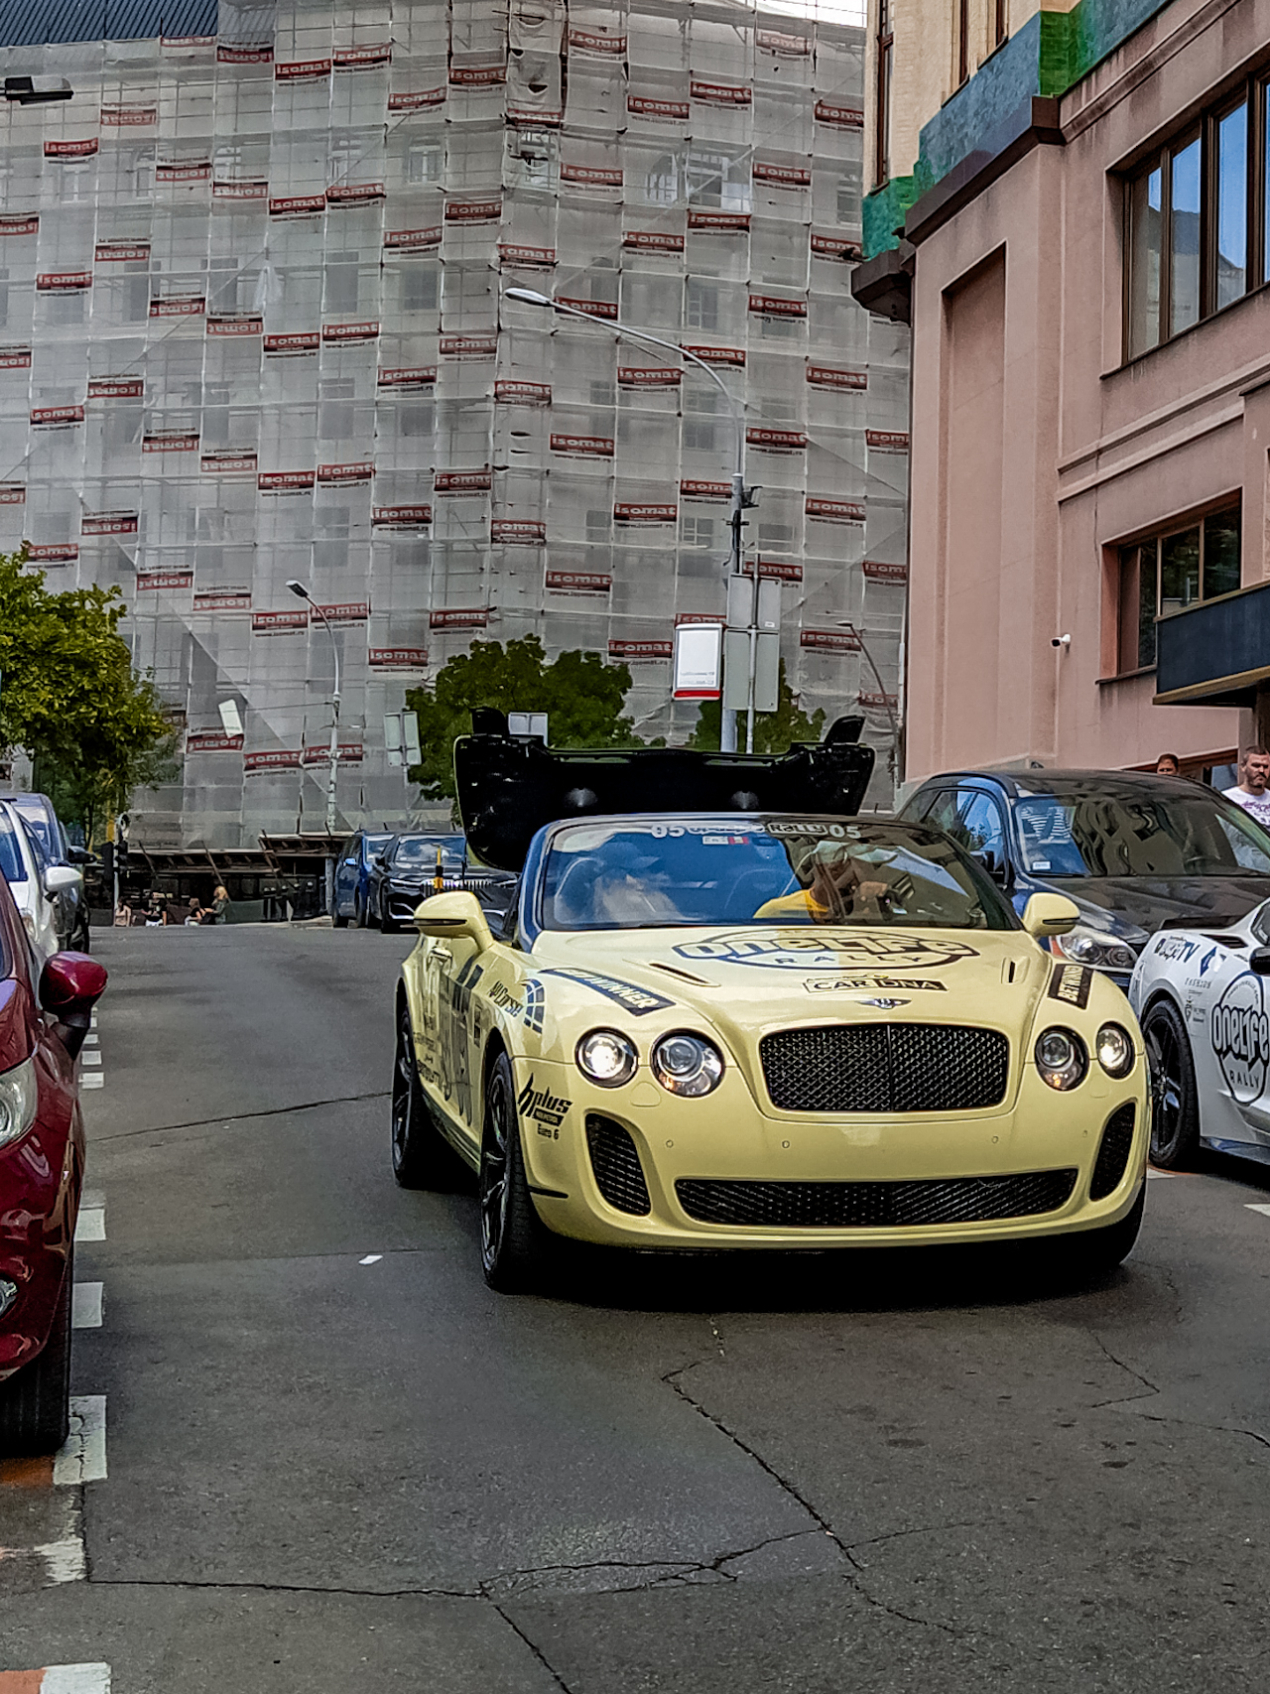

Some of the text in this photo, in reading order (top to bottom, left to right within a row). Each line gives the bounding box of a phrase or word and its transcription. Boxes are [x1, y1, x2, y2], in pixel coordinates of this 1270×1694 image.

[830, 825, 861, 839] 05
[813, 979, 940, 991] CAR DNA
[1229, 1070, 1259, 1089] RALLY
[518, 1072, 573, 1117] hplus
